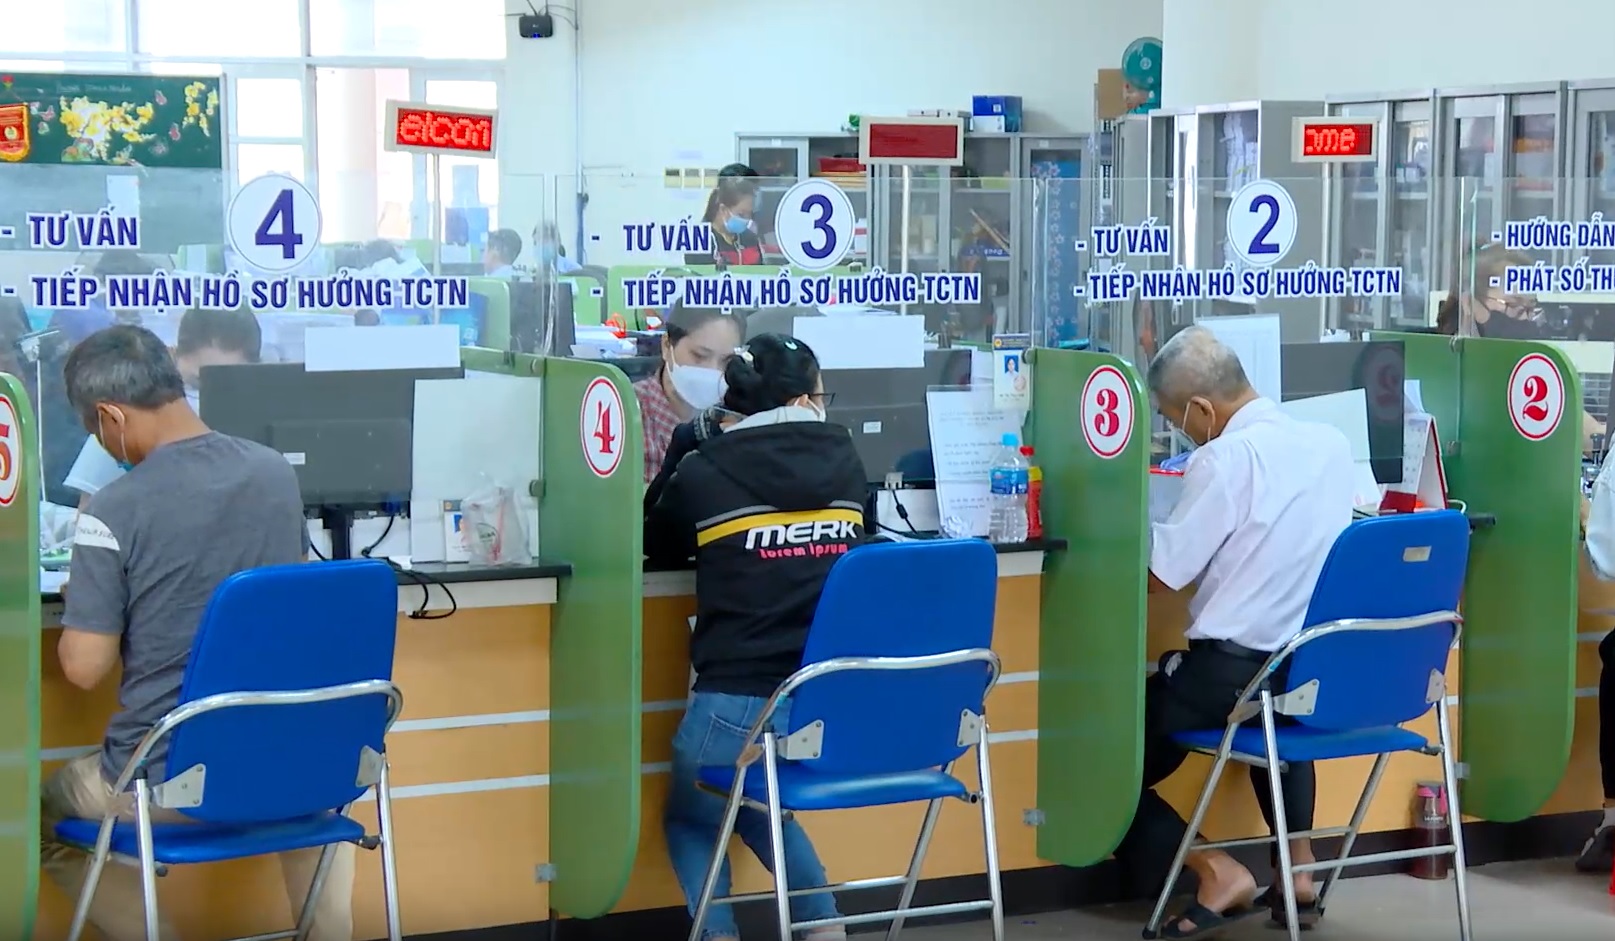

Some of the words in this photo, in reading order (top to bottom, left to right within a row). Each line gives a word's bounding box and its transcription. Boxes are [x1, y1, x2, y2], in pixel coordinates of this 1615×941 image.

[29, 213, 69, 246] TƯ
[76, 205, 138, 246] VẤN
[254, 189, 303, 260] 4
[623, 222, 655, 251] TƯ
[661, 215, 709, 251] VẤN
[800, 193, 837, 260] 3
[1094, 226, 1121, 254] TƯ
[1126, 219, 1168, 253] VẤN
[1248, 194, 1281, 255] 2
[1507, 217, 1571, 247] HƯỚNG
[1577, 213, 1615, 247] DẪN
[31, 267, 97, 307] TIẾP
[109, 271, 191, 313] NHẬN
[203, 270, 240, 308] HỒ
[251, 277, 288, 309] SƠ
[298, 269, 392, 308] HƯỞNG
[401, 278, 467, 306] TCTN
[624, 271, 676, 306] TIẾP
[685, 274, 750, 312] NHẬN
[761, 269, 791, 305] HỒ
[800, 276, 831, 305] SƠ
[839, 268, 916, 304] HƯỞNG
[924, 275, 979, 301] TCTN
[1090, 265, 1135, 299] TIẾP
[1143, 267, 1201, 302] NHẬN
[1208, 264, 1235, 296] HỒ
[1243, 269, 1270, 296] SƠ
[1276, 262, 1344, 295] HƯỞNG
[1352, 269, 1400, 293] TCTN
[1507, 262, 1554, 291] PHÁT
[1561, 258, 1586, 291] SỐ
[1591, 267, 1615, 291] TH
[1094, 389, 1120, 437] 3
[1523, 375, 1550, 422] 2
[593, 400, 616, 454] 4
[745, 520, 857, 550] MERK
